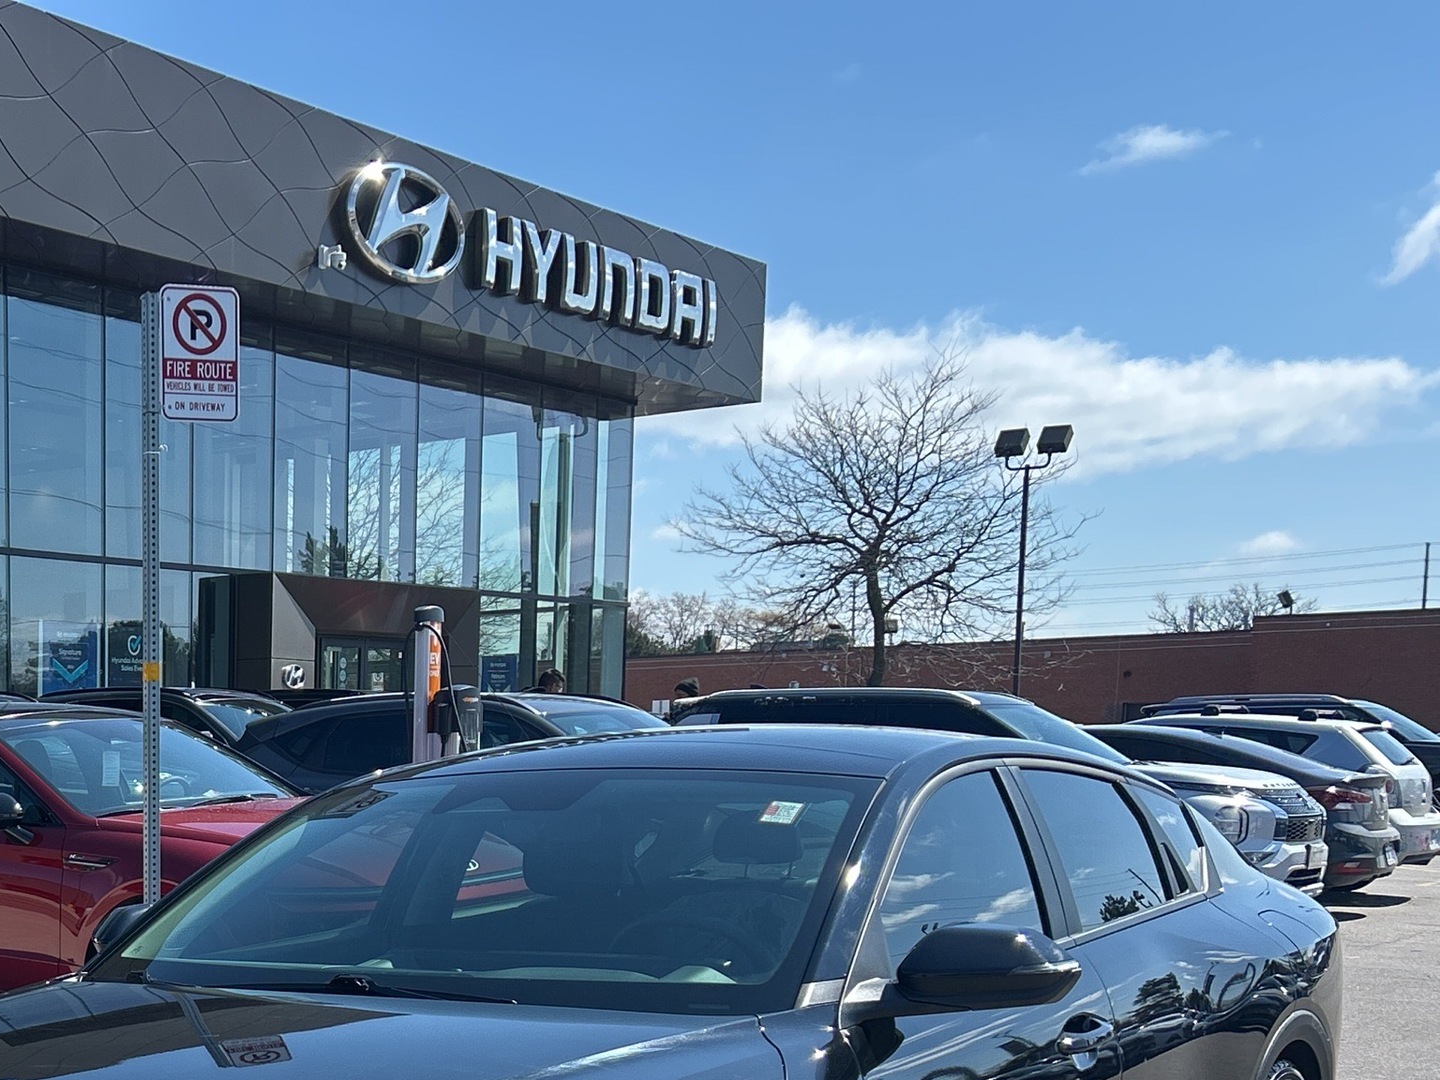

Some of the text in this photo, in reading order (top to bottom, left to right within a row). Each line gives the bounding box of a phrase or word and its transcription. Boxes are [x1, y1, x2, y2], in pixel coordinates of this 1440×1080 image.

[481, 207, 717, 349] HYUNDAI
[166, 360, 233, 379] FIRE ROUTE
[166, 381, 234, 393] VEHICLES WILL BE TOWED
[174, 401, 225, 412] ON DRIVEWAY
